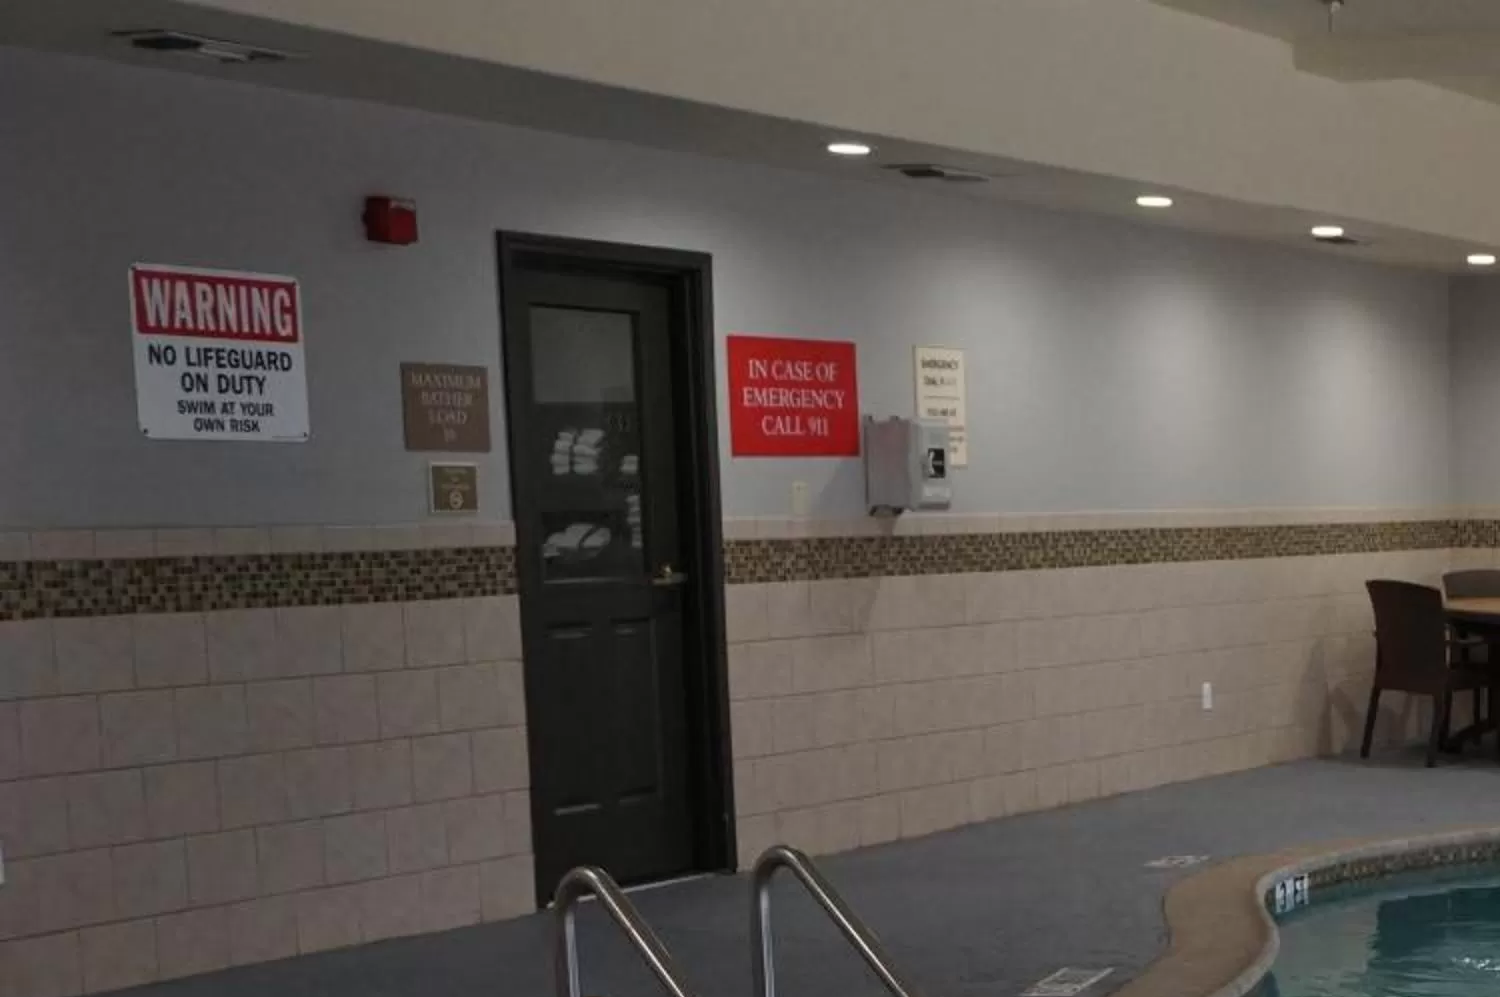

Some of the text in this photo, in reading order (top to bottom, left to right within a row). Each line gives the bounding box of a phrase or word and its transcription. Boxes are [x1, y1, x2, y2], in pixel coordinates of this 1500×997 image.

[141, 277, 293, 336] WARNING
[148, 344, 292, 371] NO LIFEGUARD
[412, 372, 481, 389] MAXIMUM
[749, 359, 838, 382] IN CASE OF
[181, 372, 266, 396] ON DUTY
[177, 400, 274, 417] SWIM AT YOUR
[743, 387, 845, 409] EMERGENCY
[193, 418, 260, 433] OWN RISK
[428, 408, 467, 424] LOAD
[761, 415, 829, 437] CALL 911
